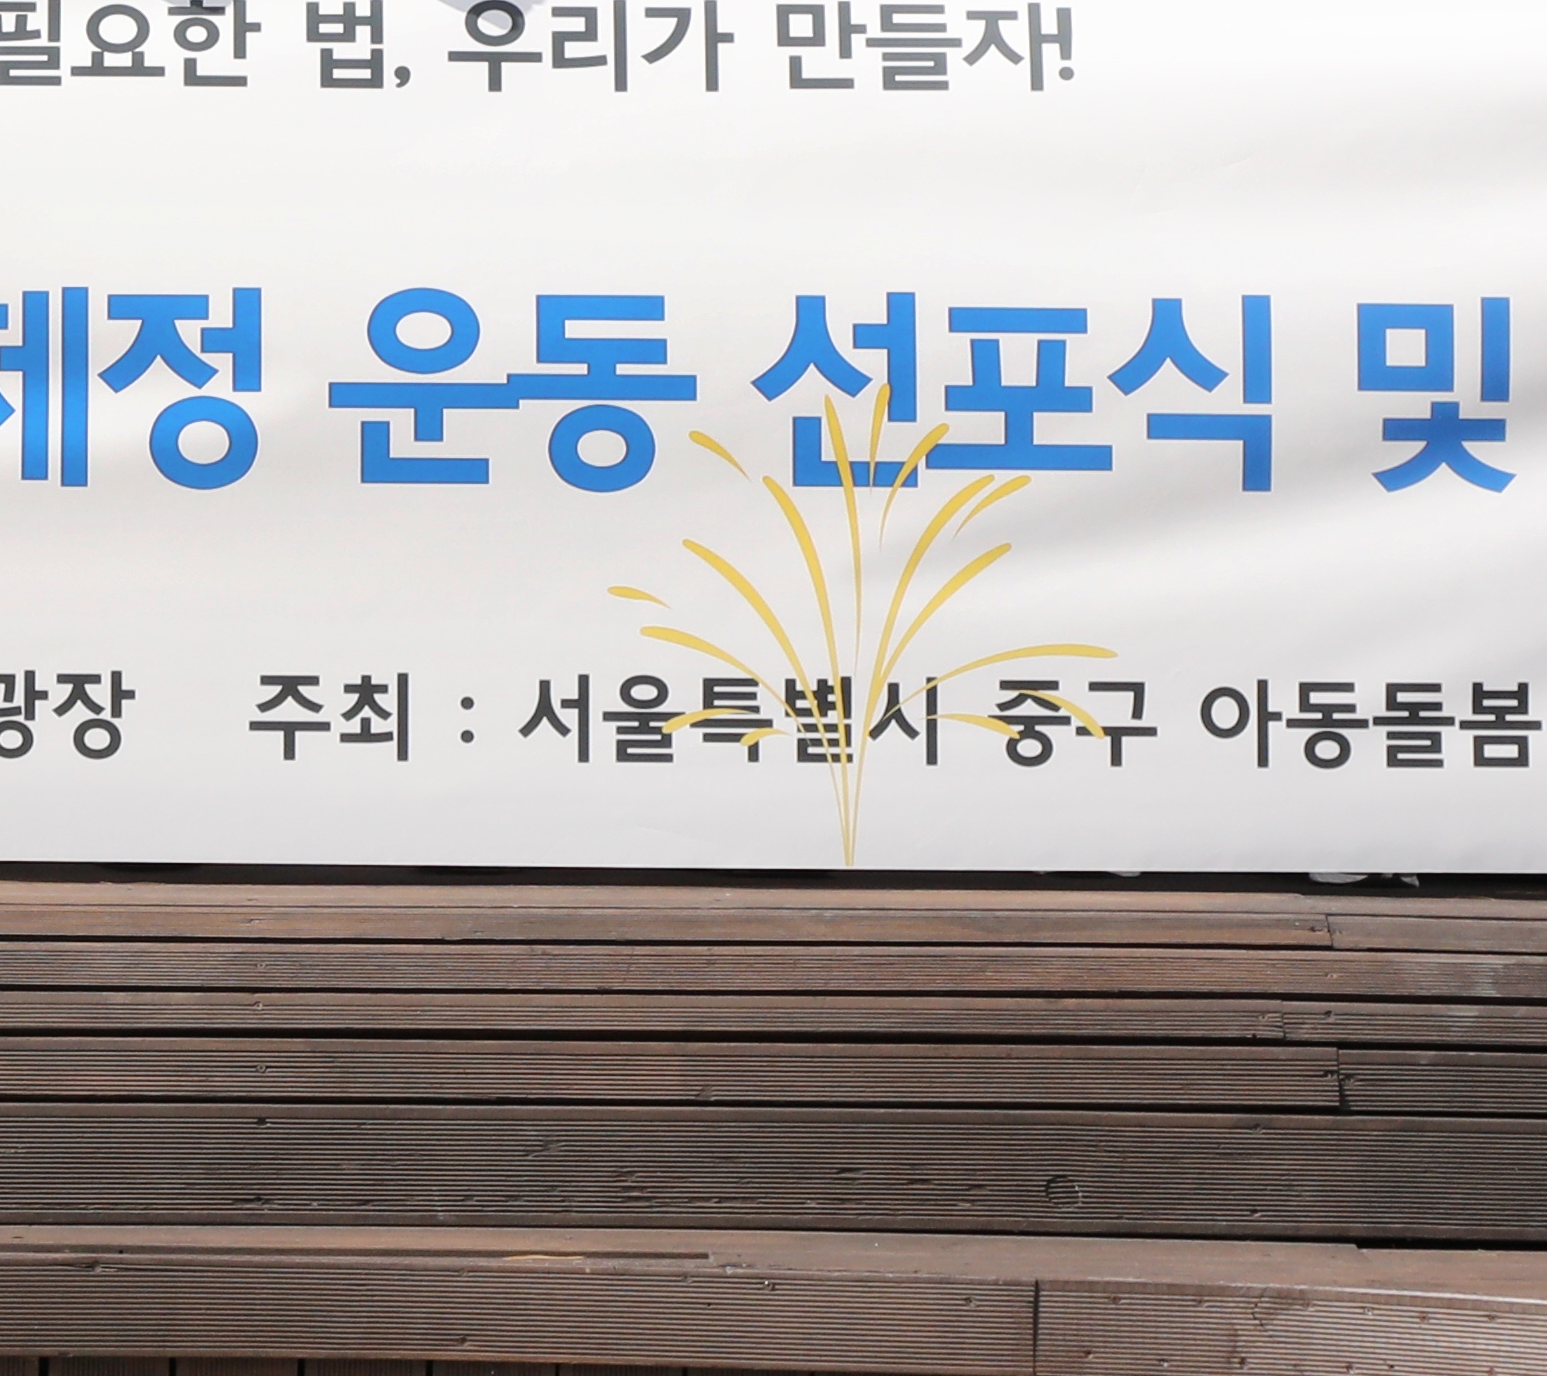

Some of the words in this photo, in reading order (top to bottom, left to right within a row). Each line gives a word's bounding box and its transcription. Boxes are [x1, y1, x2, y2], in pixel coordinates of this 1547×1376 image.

[308, 1, 409, 88] 법,
[449, 0, 729, 91] 우리가
[776, 3, 1076, 92] 만들자!
[330, 288, 697, 492] 운동
[754, 293, 1272, 491] 선포식
[1359, 298, 1514, 491] 및
[250, 673, 408, 761] 주최
[461, 697, 473, 742] :
[520, 675, 937, 765] 서울특별시
[989, 681, 1157, 766] 중구
[1201, 680, 1541, 768] 아동돌봄
